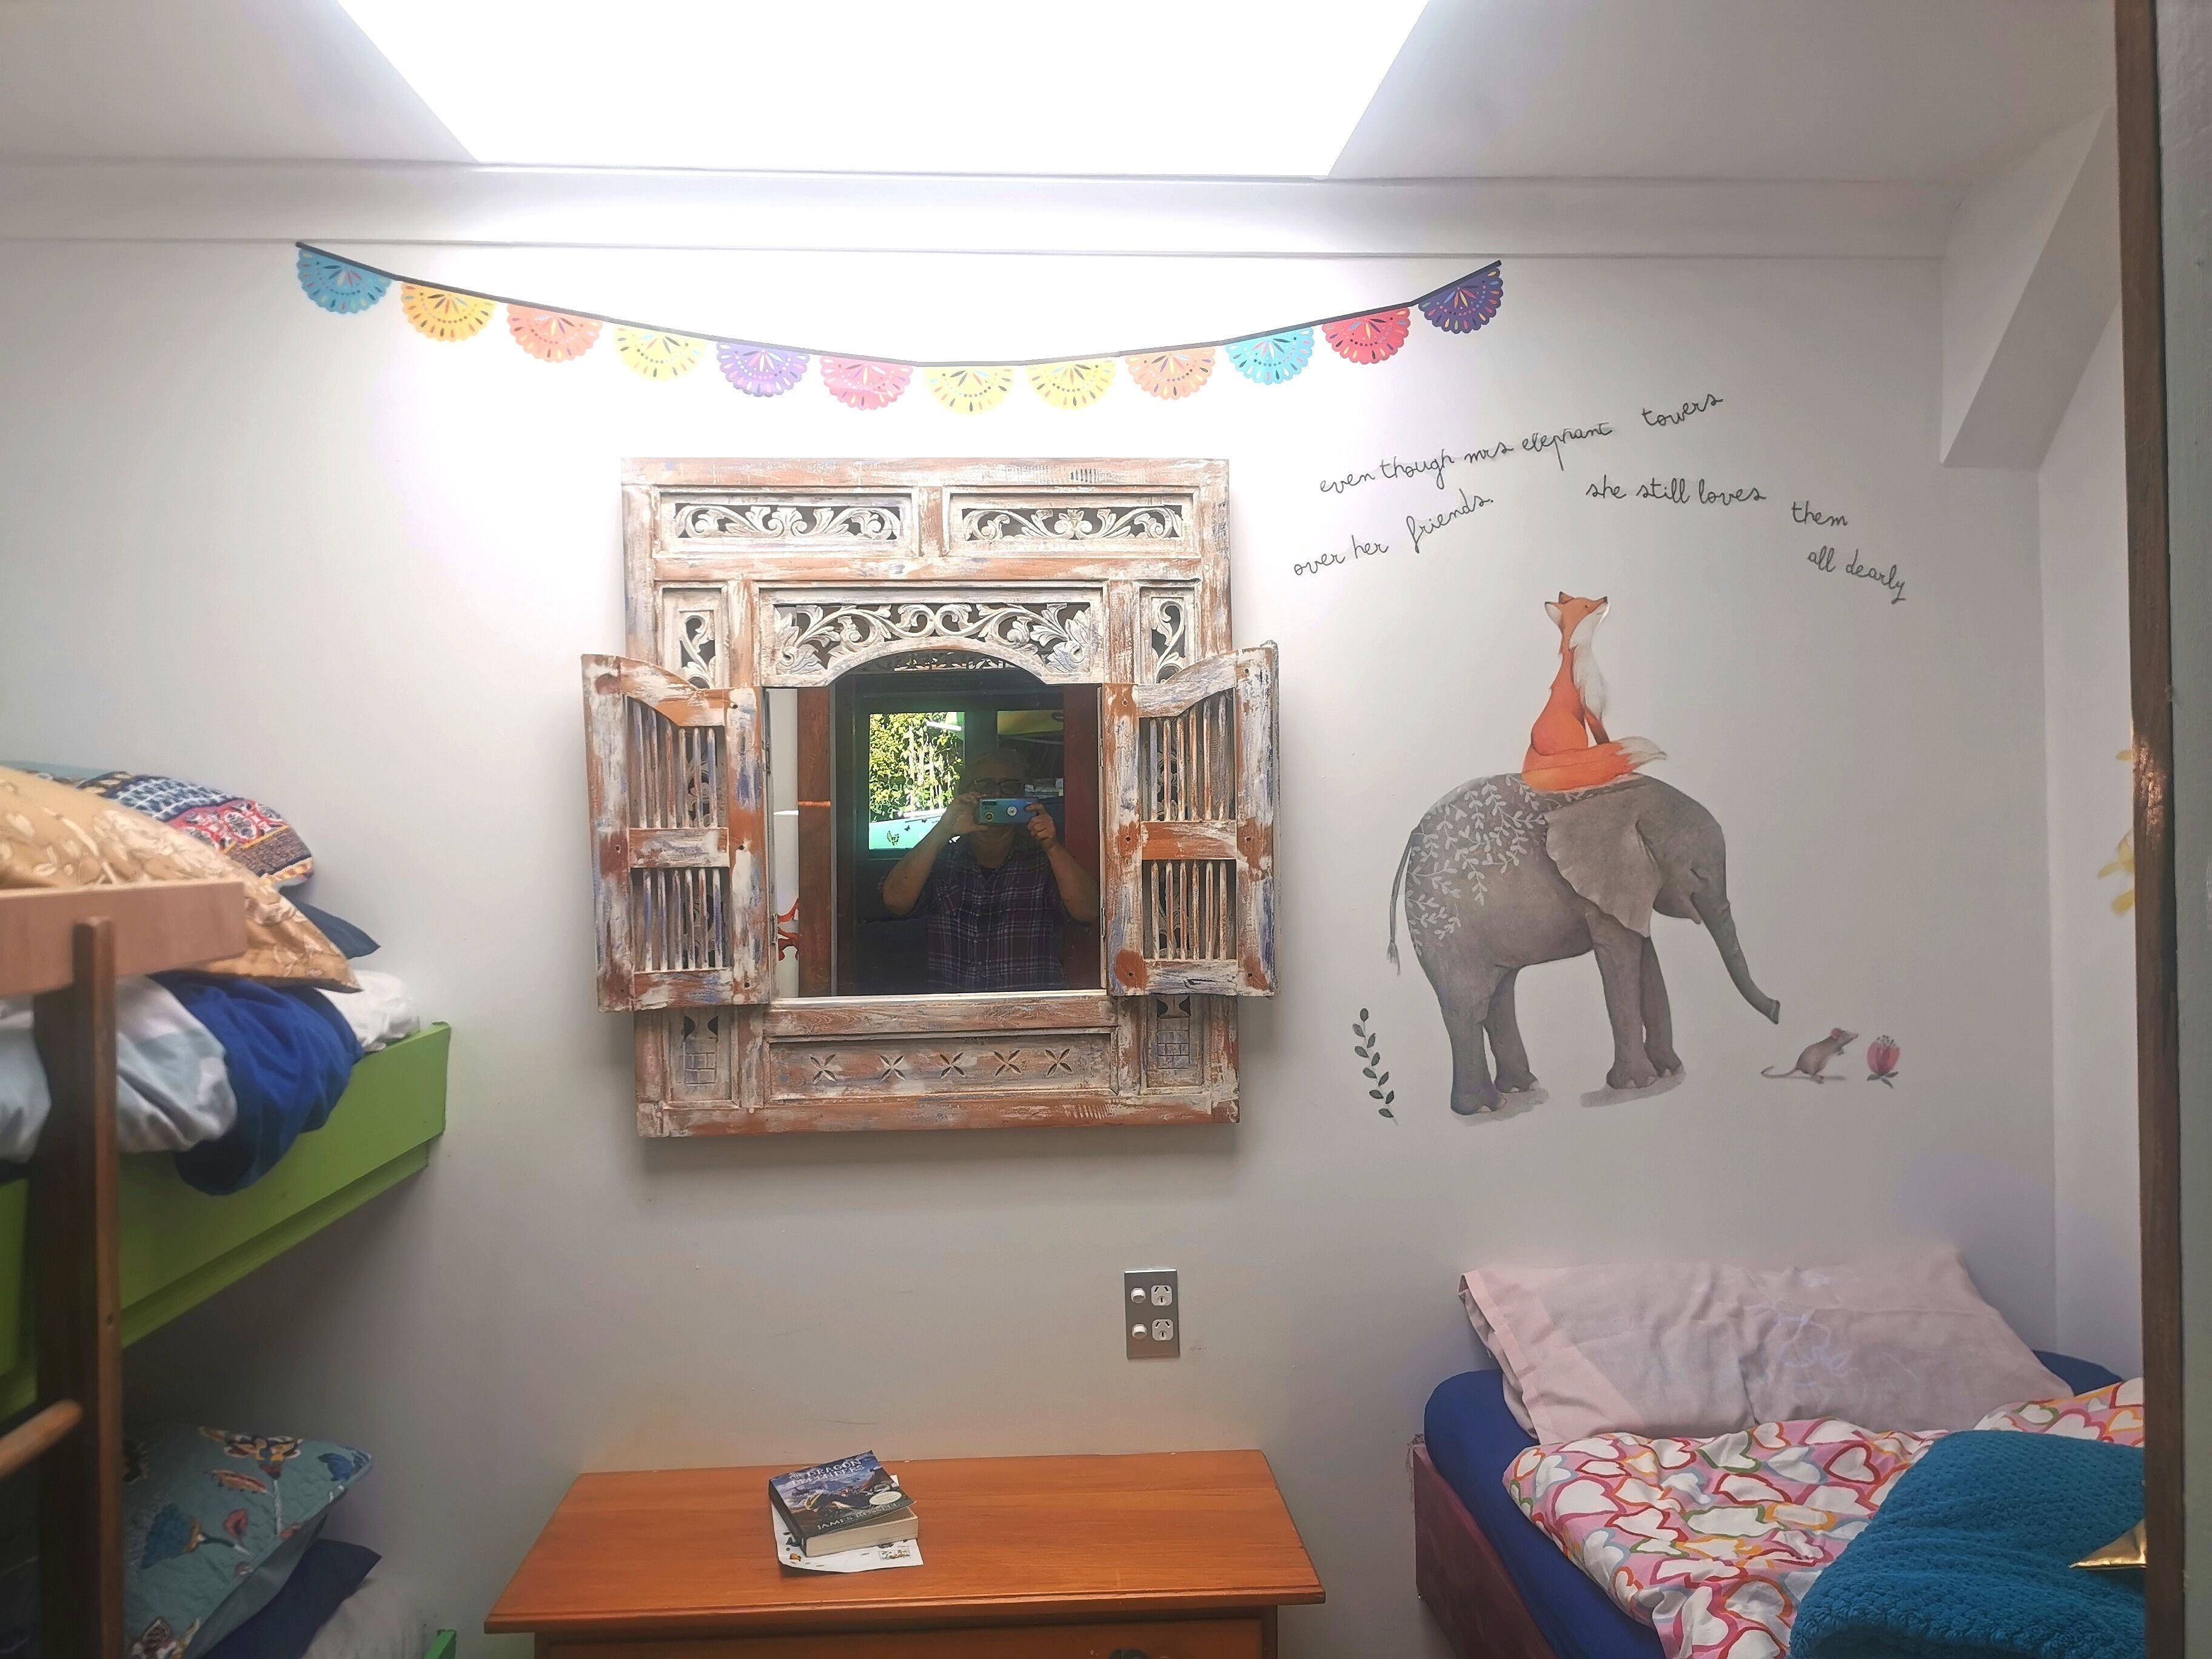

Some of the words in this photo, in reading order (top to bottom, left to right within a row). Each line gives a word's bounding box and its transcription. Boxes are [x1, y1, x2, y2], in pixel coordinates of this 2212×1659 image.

[1319, 473, 1376, 494] even
[1379, 449, 1455, 490] though
[1464, 442, 1514, 463] mrs
[1521, 421, 1614, 471] elephant
[1641, 394, 1723, 426] towers
[1585, 474, 1627, 499] she
[1636, 477, 1691, 504] still
[1698, 478, 1767, 506] loves
[1791, 500, 1848, 526] them
[1293, 553, 1346, 576] over
[1351, 535, 1389, 560] her
[1807, 545, 1837, 573] all
[1845, 548, 1906, 605] dearly
[806, 1458, 862, 1478] DRAGON
[817, 1516, 854, 1530] JAMES
